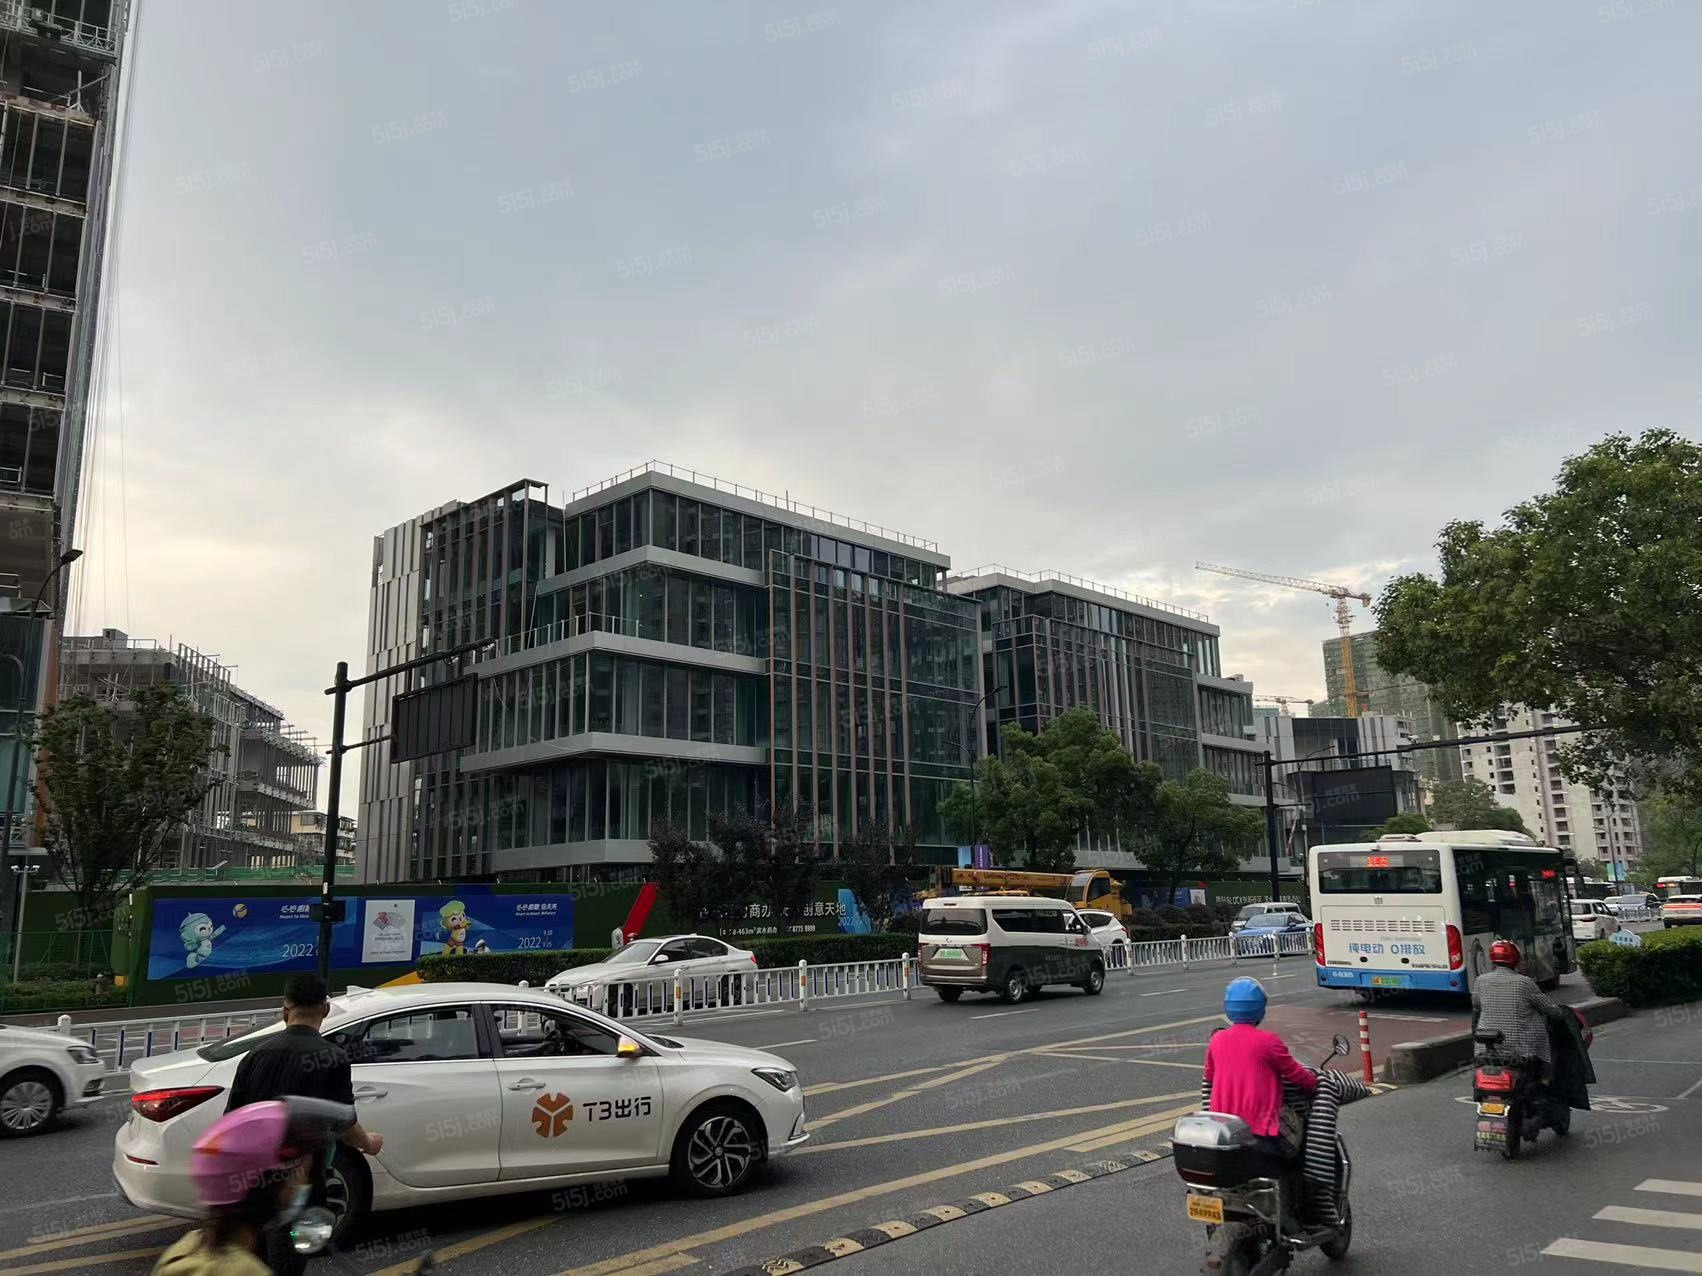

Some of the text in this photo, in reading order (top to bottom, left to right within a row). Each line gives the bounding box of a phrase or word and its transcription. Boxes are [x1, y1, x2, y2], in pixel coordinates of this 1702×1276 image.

[518, 936, 542, 949] 2022
[282, 943, 313, 958] 2022
[582, 1096, 652, 1122] T3出行
